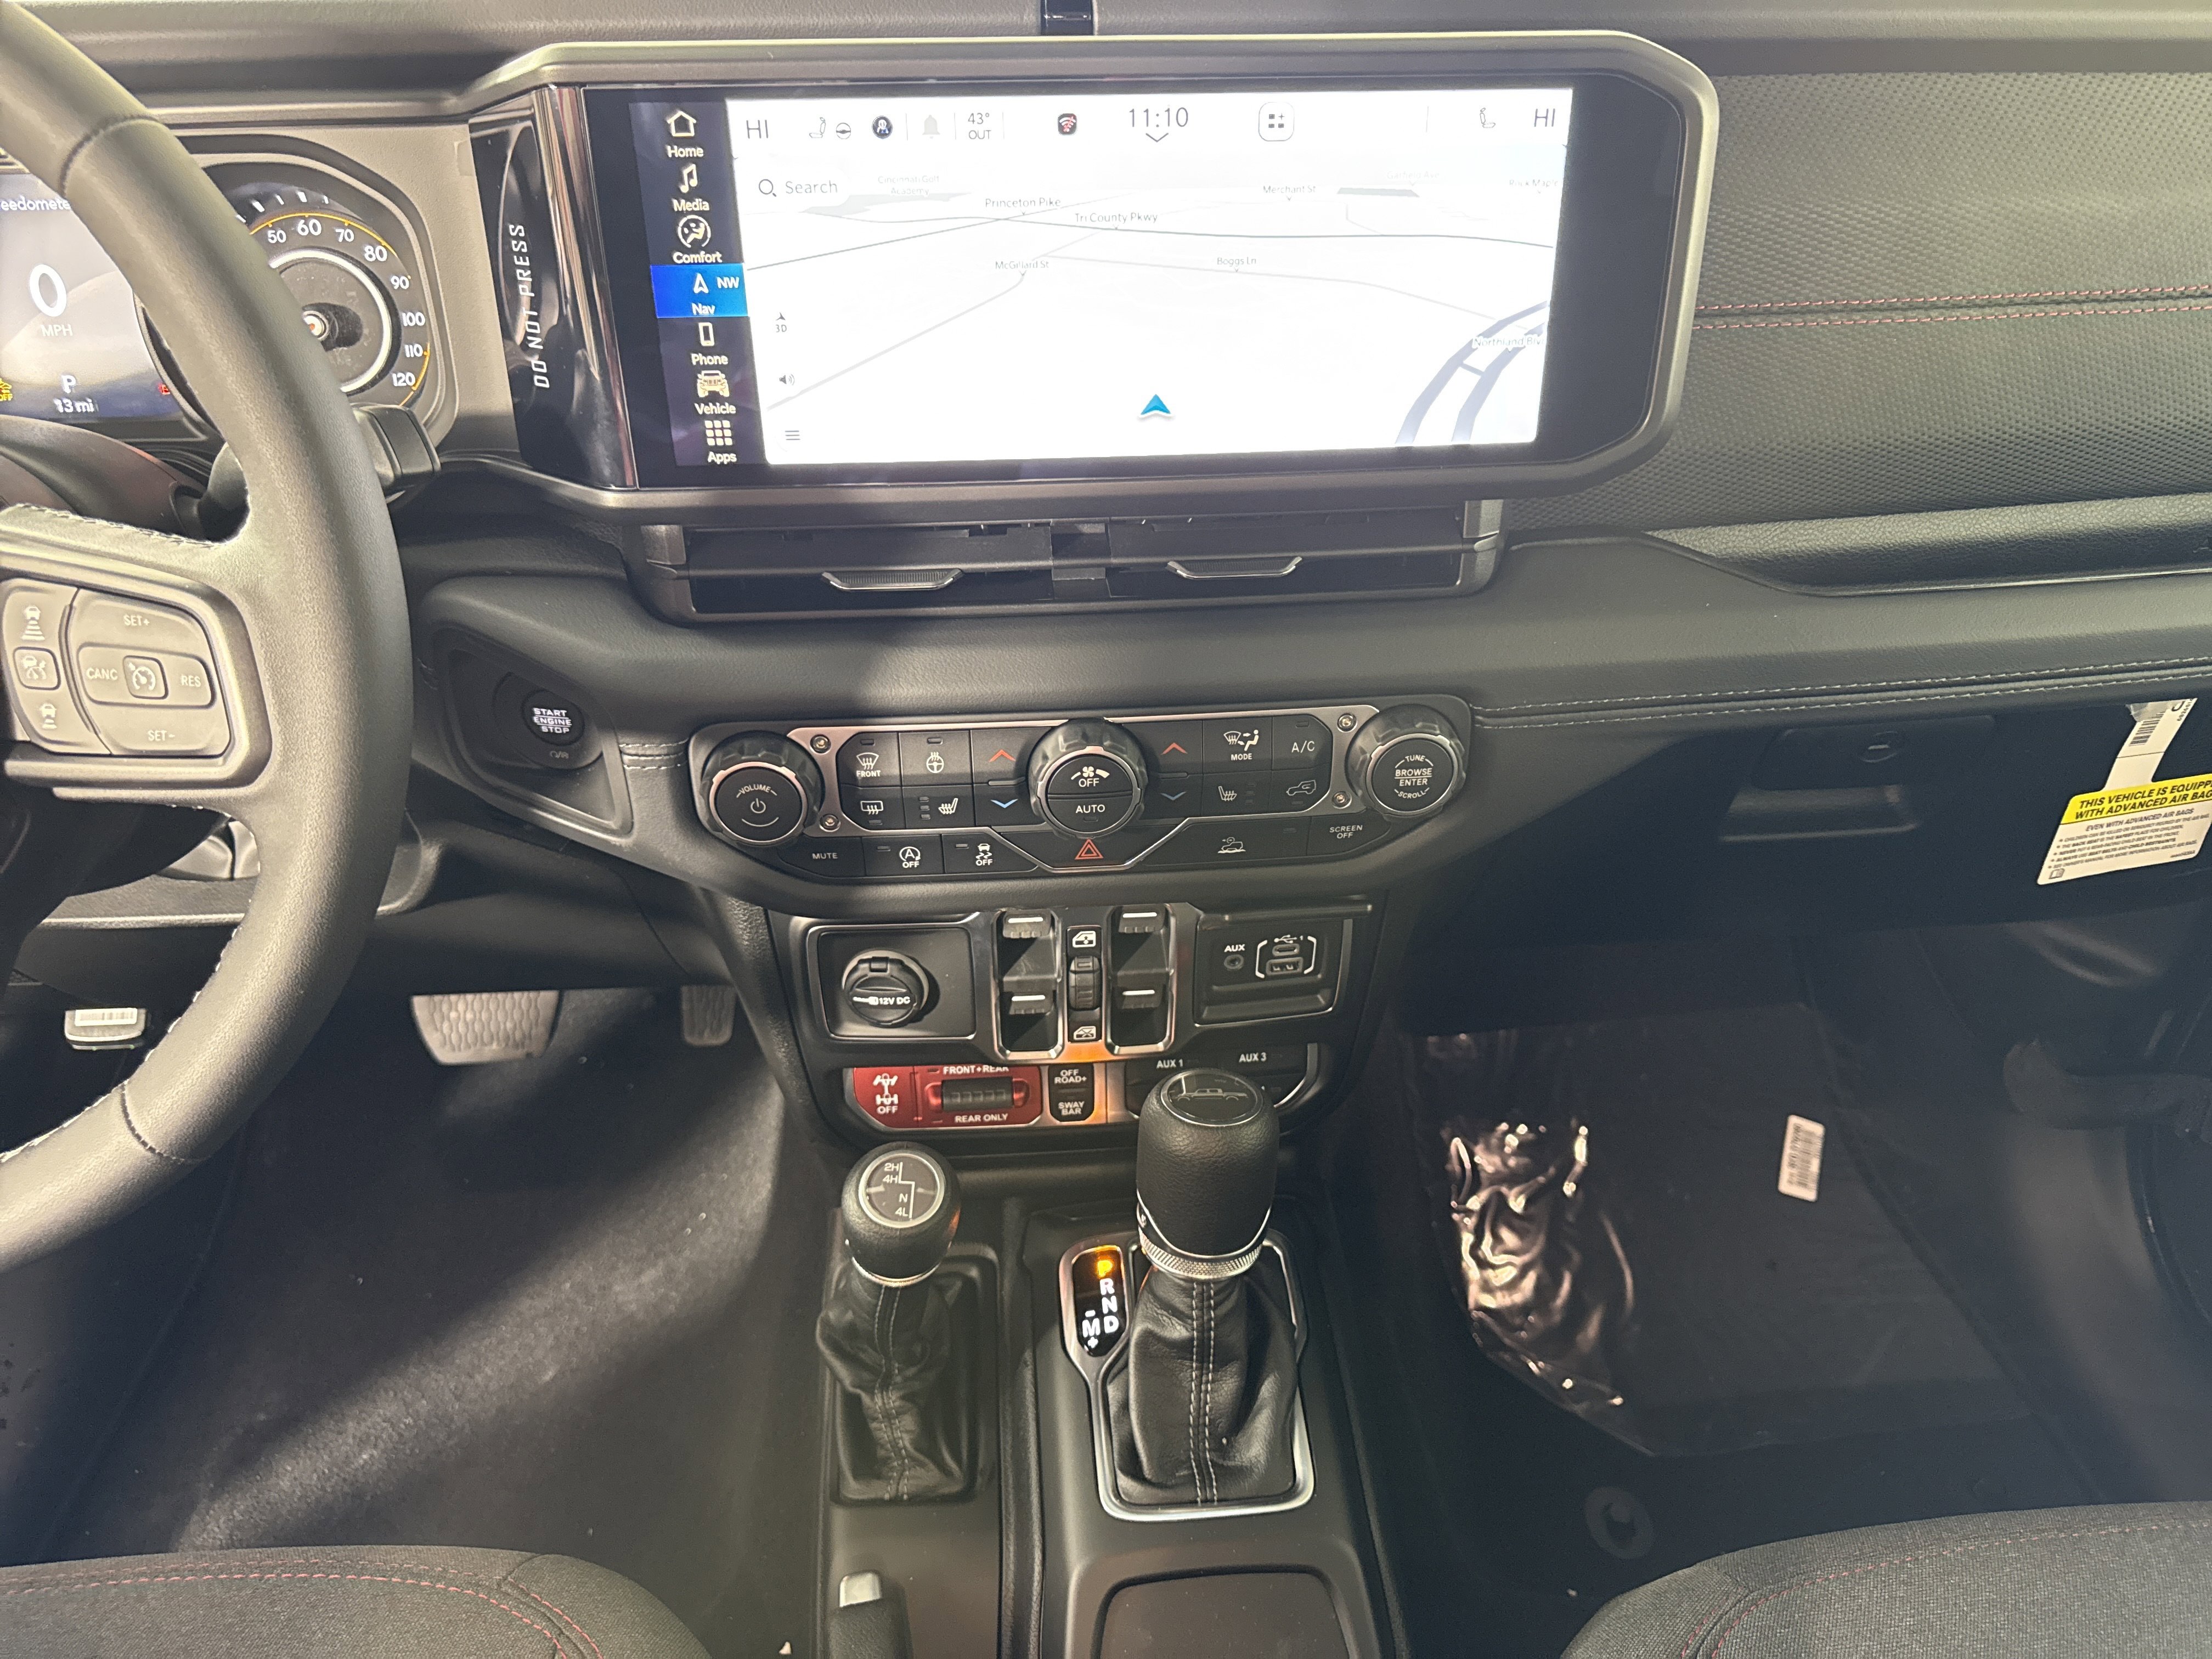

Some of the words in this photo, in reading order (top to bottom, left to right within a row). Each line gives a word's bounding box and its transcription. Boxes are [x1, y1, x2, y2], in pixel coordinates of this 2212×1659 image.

[1128, 106, 1189, 128] 11:10
[1534, 108, 1556, 127] HI
[746, 119, 769, 139] HI
[968, 129, 991, 140] OUT
[667, 145, 704, 158] Home
[785, 180, 839, 195] Search
[1263, 185, 1305, 194] Merchant
[1307, 185, 1316, 193] St
[672, 198, 710, 212] Media
[985, 198, 1036, 208] Princeton
[1039, 198, 1062, 207] Pike
[1075, 213, 1087, 222] Tri
[1090, 212, 1128, 224] County
[1130, 212, 1158, 224] Pkwy
[297, 219, 322, 236] 60
[267, 229, 286, 244] 50
[335, 228, 354, 242] 70
[364, 245, 387, 262] 80
[672, 251, 723, 264] Comfort
[509, 224, 535, 297] PRESS
[1040, 260, 1049, 269] St
[1217, 257, 1244, 267] Boggs
[390, 275, 409, 289] 90
[716, 276, 740, 289] NW
[29, 264, 67, 317] 0
[691, 303, 716, 315] Nav
[402, 312, 426, 326] 100
[41, 324, 73, 337] MPH
[522, 307, 543, 349] NOT
[775, 324, 788, 333] 3D
[1474, 336, 1524, 346] Northland
[404, 343, 424, 358] 110
[691, 353, 729, 365] Phone
[392, 372, 416, 387] 120
[531, 359, 550, 388] DO
[61, 375, 76, 394] P
[75, 397, 94, 413] mi
[693, 402, 736, 415] Vehicle
[707, 452, 737, 464] Apps
[86, 667, 119, 681] CANC
[180, 675, 201, 688] RES
[533, 707, 567, 717] START
[533, 716, 572, 726] ENGINE
[541, 726, 570, 734] STOP
[1291, 740, 1316, 753] A/C
[1230, 753, 1252, 761] MODE
[1404, 754, 1426, 763] TUNE
[856, 770, 881, 778] FRONT
[1395, 768, 1432, 777] BROWSE
[1078, 778, 1100, 787] OFF
[1398, 777, 1428, 787] ENTER
[738, 783, 771, 794] VOLUME
[1397, 789, 1427, 800] SCROLL
[2079, 797, 2106, 809] THIS
[2108, 788, 2155, 804] VEHICLE
[2156, 787, 2169, 796] IS
[1075, 804, 1105, 814] AUTO
[2075, 807, 2104, 820] WITH
[2106, 797, 2168, 815] ADVANCED
[2169, 793, 2188, 804] AIR
[1329, 825, 1363, 833] SCREEN
[812, 852, 838, 860] MUTE
[975, 858, 993, 866] OFF
[1224, 944, 1246, 952] AUX
[879, 996, 895, 1005] 12V
[896, 996, 911, 1005] DC
[1238, 1052, 1260, 1063] AUX
[1260, 1052, 1267, 1062] 3
[1156, 1059, 1177, 1069] AUX
[1178, 1059, 1184, 1068] 1
[1054, 1075, 1087, 1084] ROAD+
[876, 1105, 898, 1114] OFF
[1058, 1101, 1085, 1110] SWAY
[1060, 1107, 1082, 1116] BAR
[955, 1114, 981, 1123] REAR
[983, 1113, 1008, 1122] ONLY
[884, 1163, 900, 1172] 2H
[882, 1174, 899, 1184] 4H
[899, 1193, 908, 1203] N
[895, 1207, 909, 1217] 4L
[1097, 1260, 1113, 1278] P
[1099, 1278, 1114, 1295] R
[1101, 1296, 1118, 1314] N
[1082, 1319, 1101, 1338] M
[1103, 1316, 1119, 1334] D
